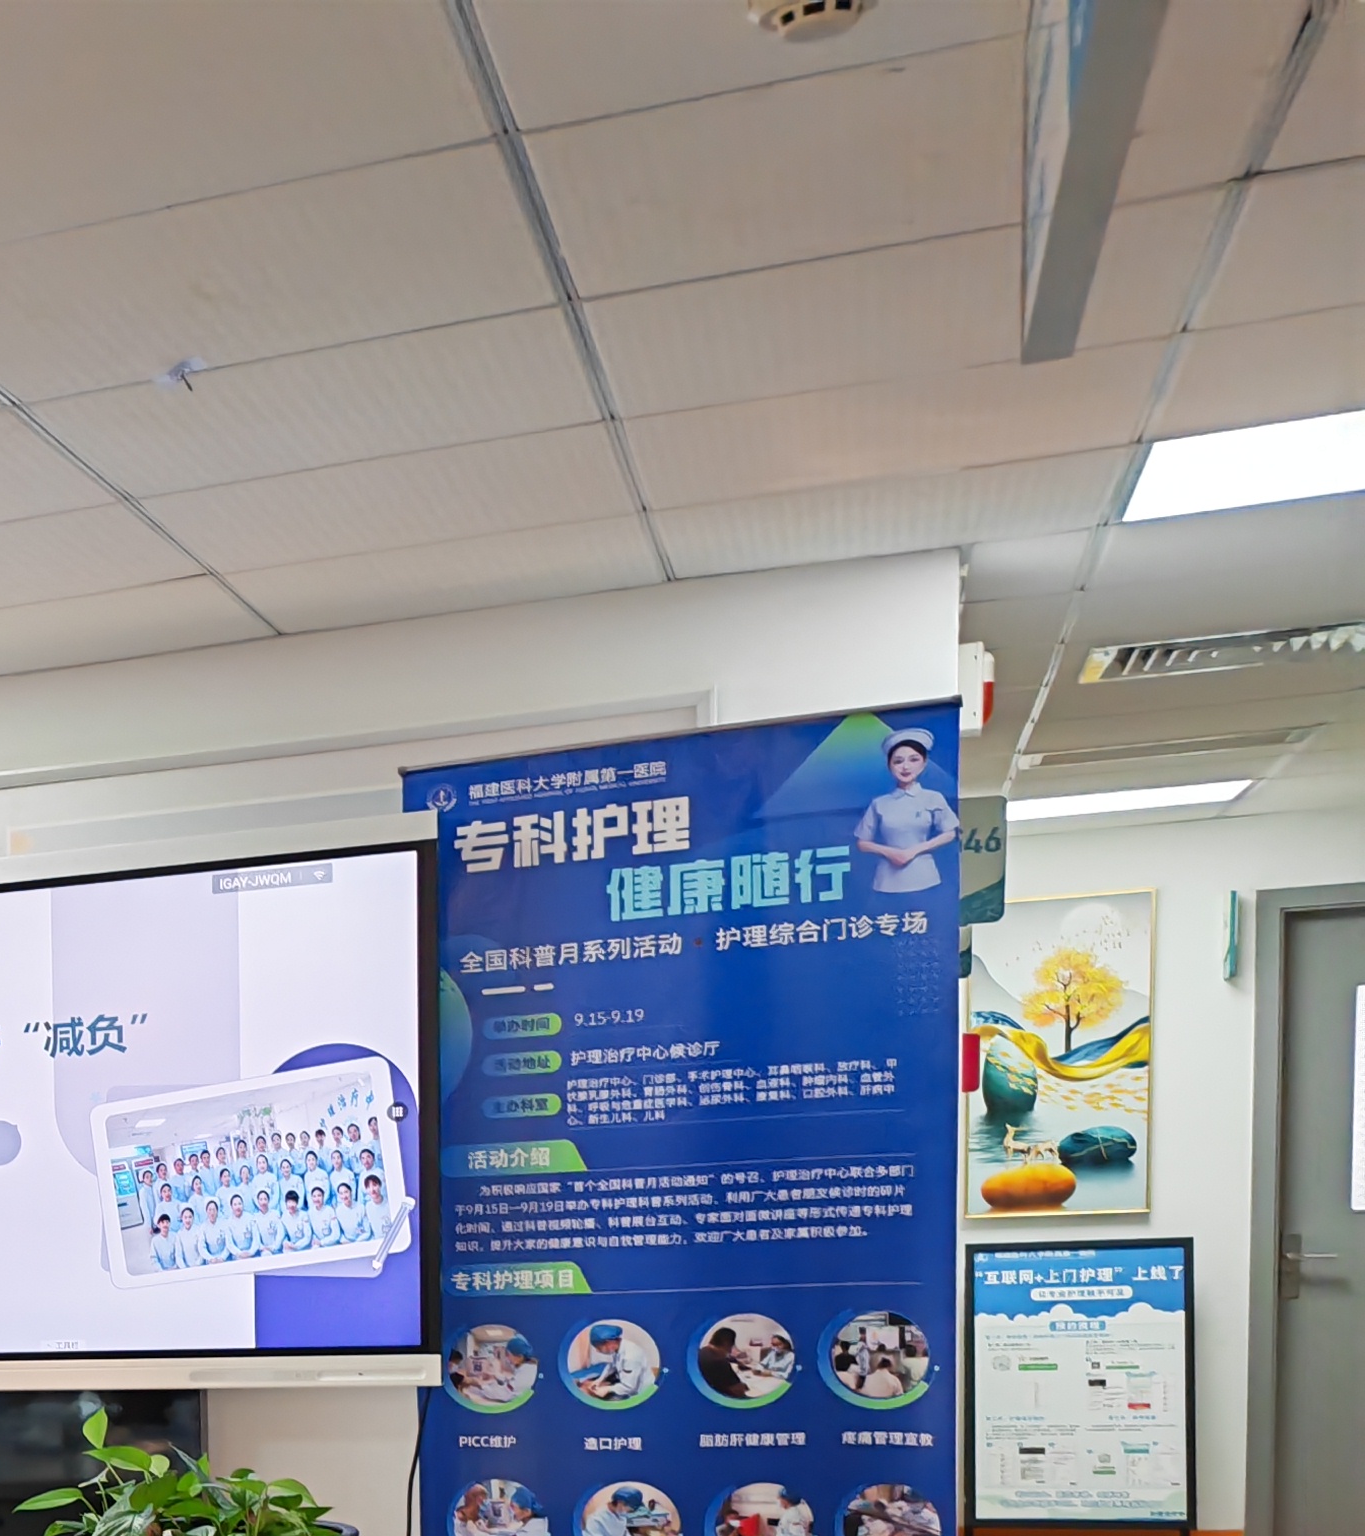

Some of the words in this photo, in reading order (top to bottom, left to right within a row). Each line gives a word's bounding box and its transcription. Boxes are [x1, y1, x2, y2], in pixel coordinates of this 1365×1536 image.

[469, 761, 666, 800] 福建医科大学附属第一医院
[454, 796, 690, 873] 专科护理
[959, 827, 1002, 854] 46
[606, 845, 851, 922] 健康随行
[459, 933, 682, 974] 全国科普月系列活动
[716, 911, 927, 952] 护理综合门诊专场
[574, 1008, 645, 1028] 9.15-9.19
[571, 1040, 720, 1067] 护理治疗中心候诊厅
[468, 1147, 550, 1170] 活动介绍
[451, 1268, 575, 1291] 专科护理项目
[459, 1434, 516, 1449] PICC维护
[583, 1437, 643, 1451] 造口护理
[699, 1431, 806, 1449] 脂肪肝健康管理
